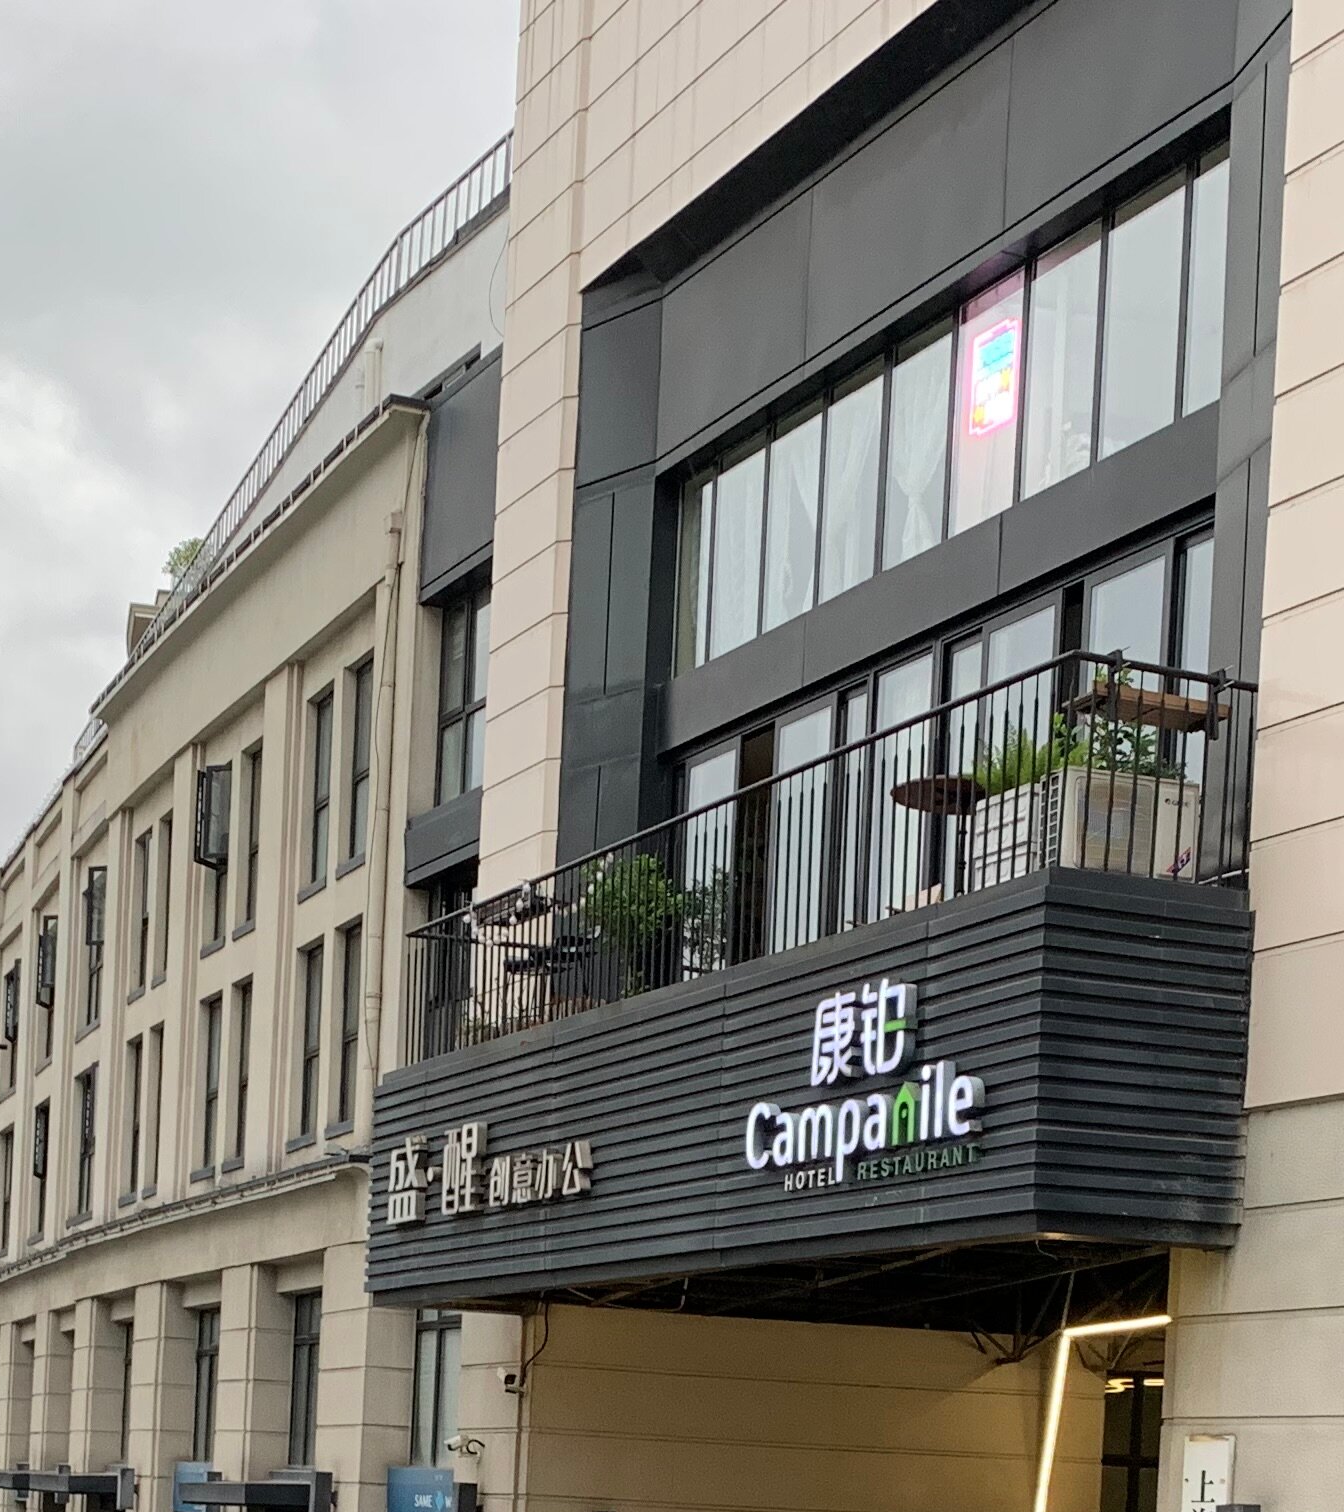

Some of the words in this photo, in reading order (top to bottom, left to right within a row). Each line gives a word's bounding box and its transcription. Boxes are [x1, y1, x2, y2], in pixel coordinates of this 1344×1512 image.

[810, 978, 910, 1087] 康铂
[745, 1059, 981, 1182] Campanile
[488, 1140, 592, 1208] 创意办公
[783, 1166, 836, 1192] HOTEL
[856, 1143, 978, 1181] RESTAURANT
